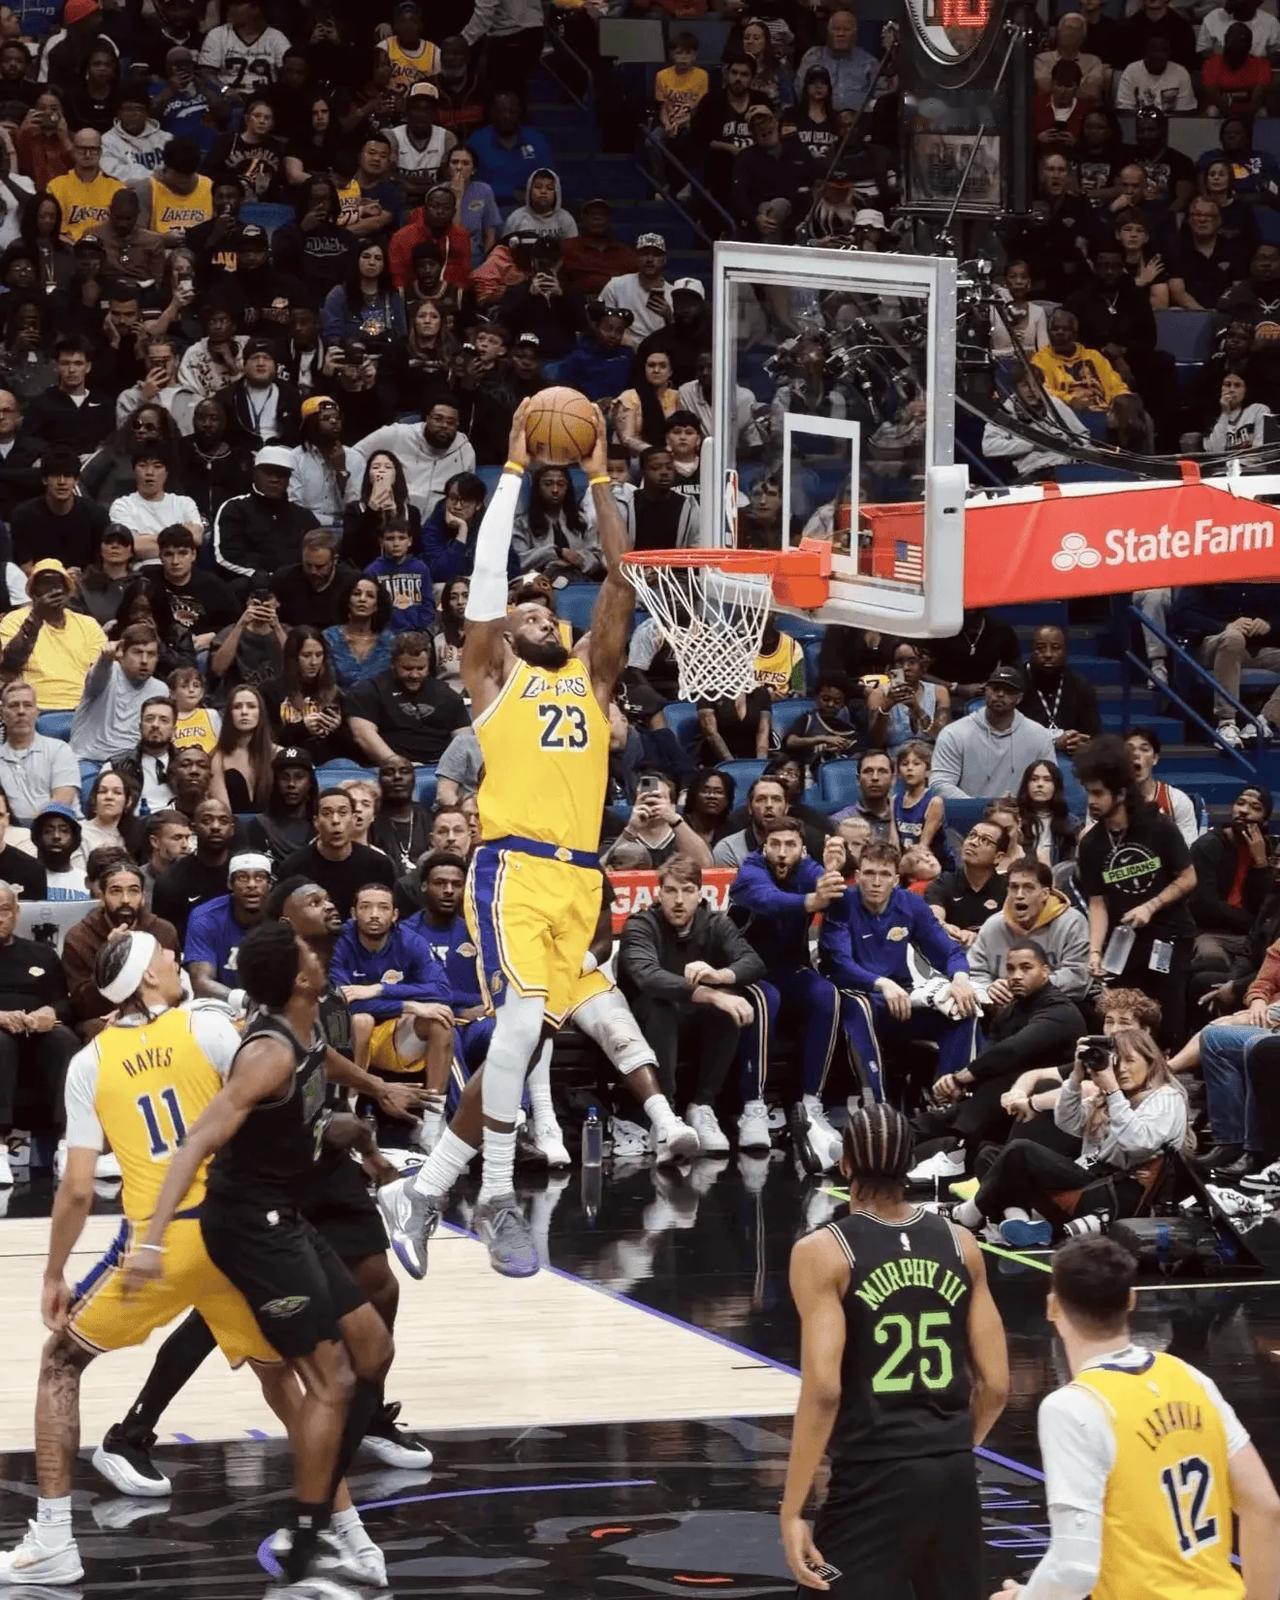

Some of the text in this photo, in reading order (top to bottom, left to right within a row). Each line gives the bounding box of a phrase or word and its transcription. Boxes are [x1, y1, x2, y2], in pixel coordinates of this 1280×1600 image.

[1105, 518, 1274, 566] State Farm
[538, 703, 589, 749] 23
[1108, 860, 1156, 881] PELICANS
[122, 1048, 173, 1078] HAYES
[137, 1087, 187, 1156] 11
[854, 1257, 968, 1311] MURPHY III
[872, 1311, 953, 1393] 25
[1161, 1456, 1217, 1552] 12
